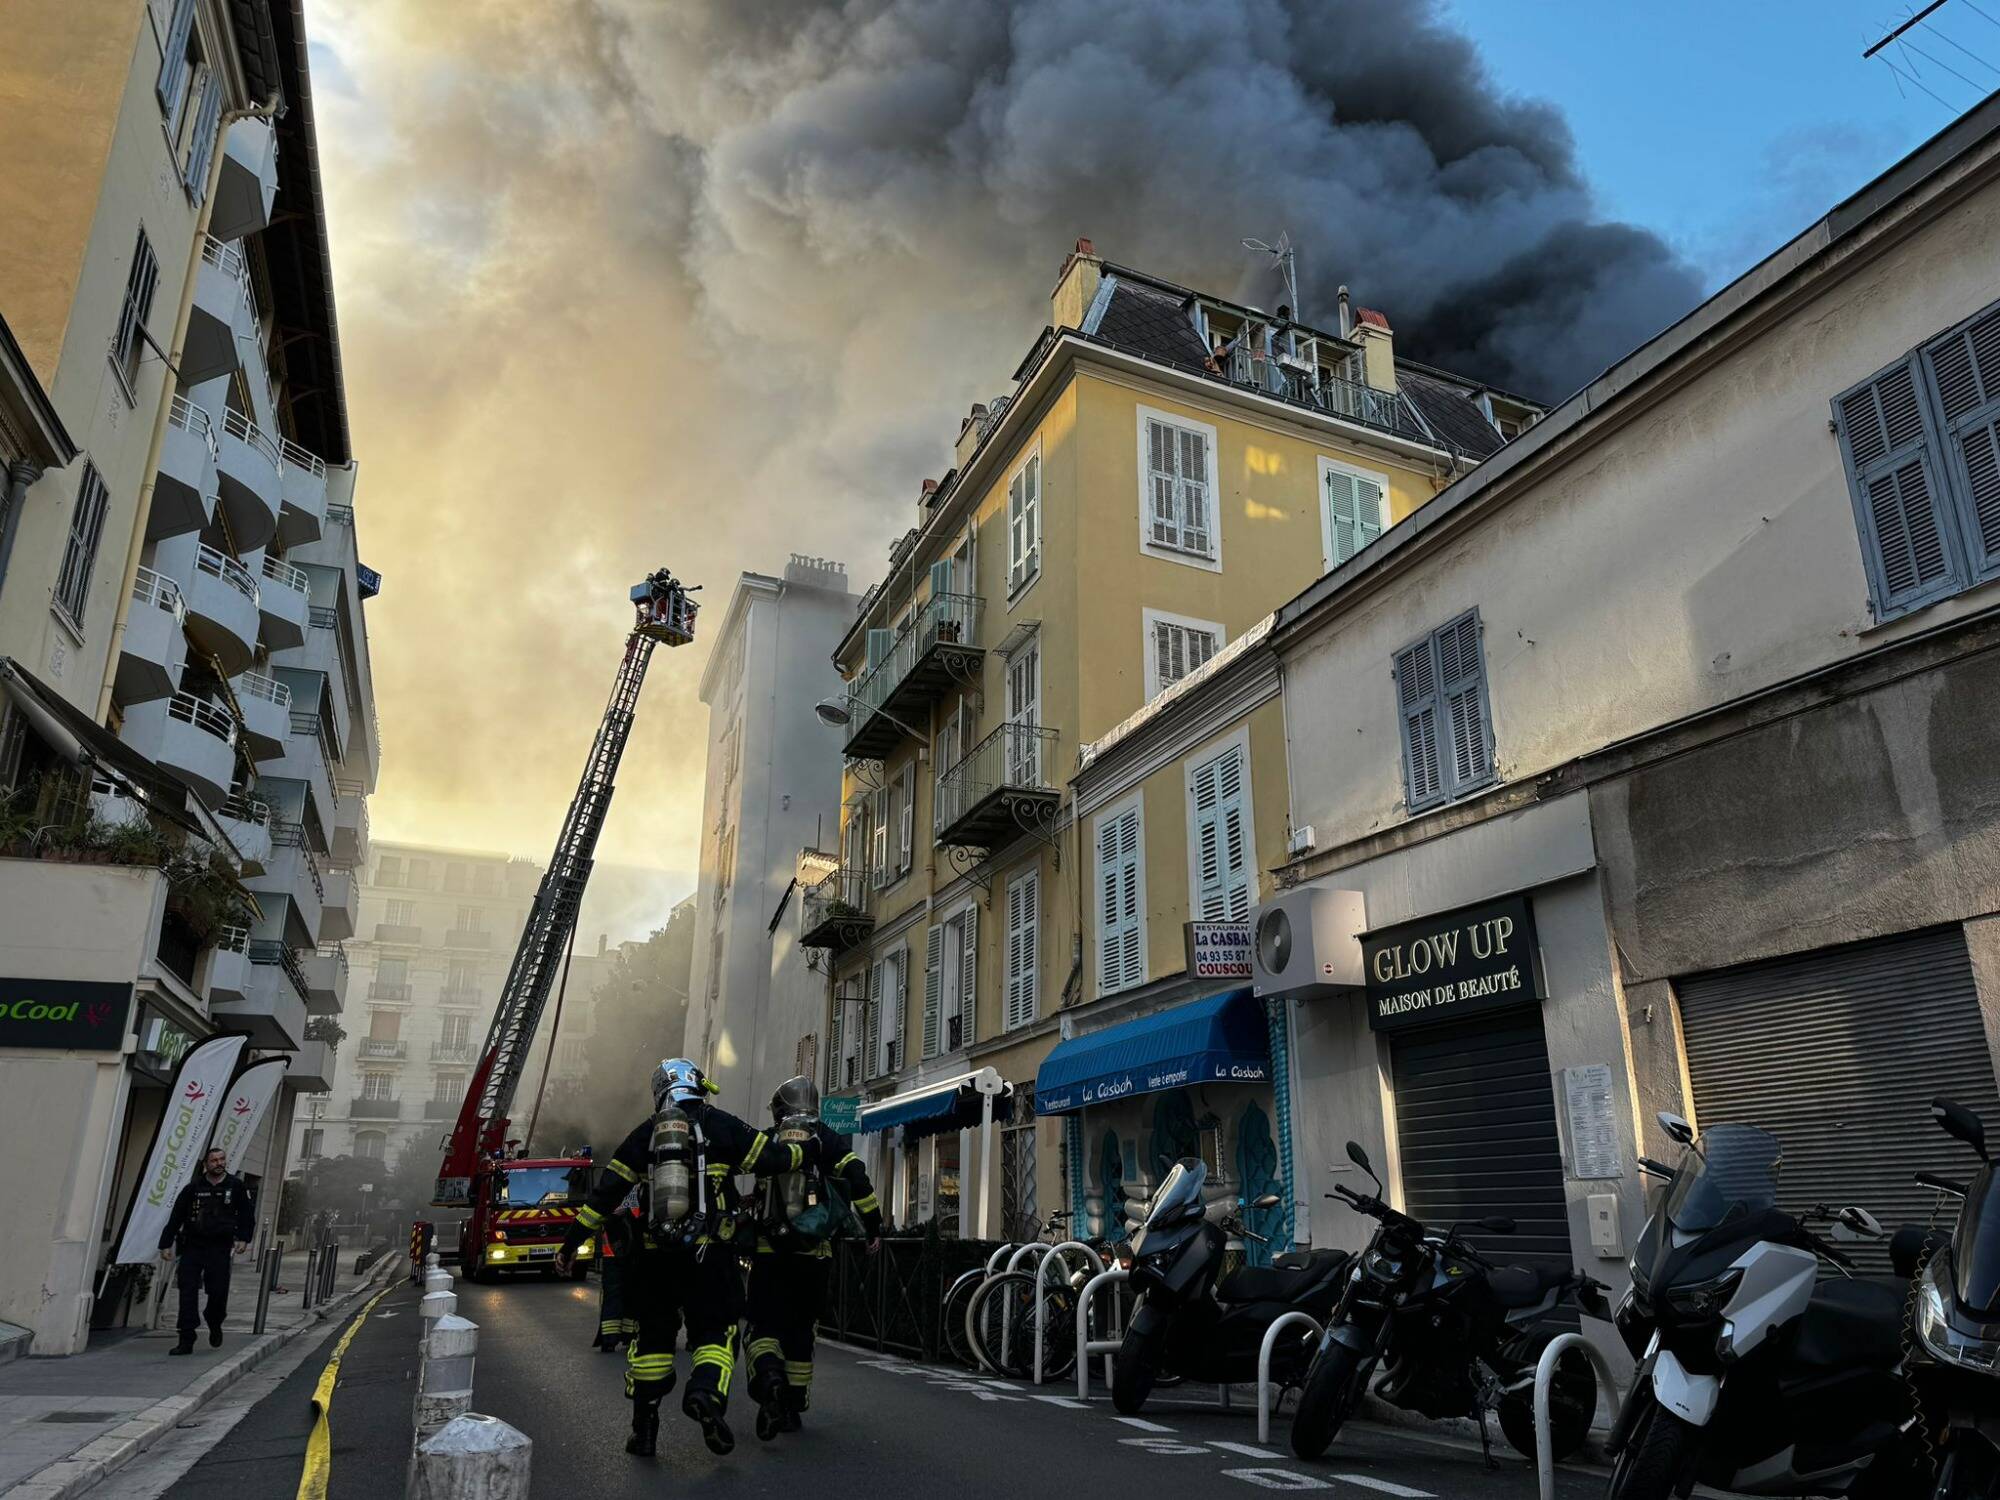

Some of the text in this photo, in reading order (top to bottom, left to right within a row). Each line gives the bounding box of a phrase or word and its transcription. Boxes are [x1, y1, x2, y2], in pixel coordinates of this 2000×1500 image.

[1195, 932, 1208, 946] La
[1374, 916, 1513, 983] GLOW UP
[1196, 951, 1208, 962] 04
[1209, 951, 1221, 962] 93
[1222, 950, 1234, 961] 55
[1235, 950, 1246, 961] 87
[1198, 962, 1253, 975] COUSCOU
[1378, 964, 1521, 1017] MAISON DE BEAUTÉ
[1215, 1064, 1265, 1078] La Casbah
[1082, 1084, 1093, 1103] La
[1097, 1075, 1133, 1099] Casbah
[147, 1104, 194, 1207] KeepCool
